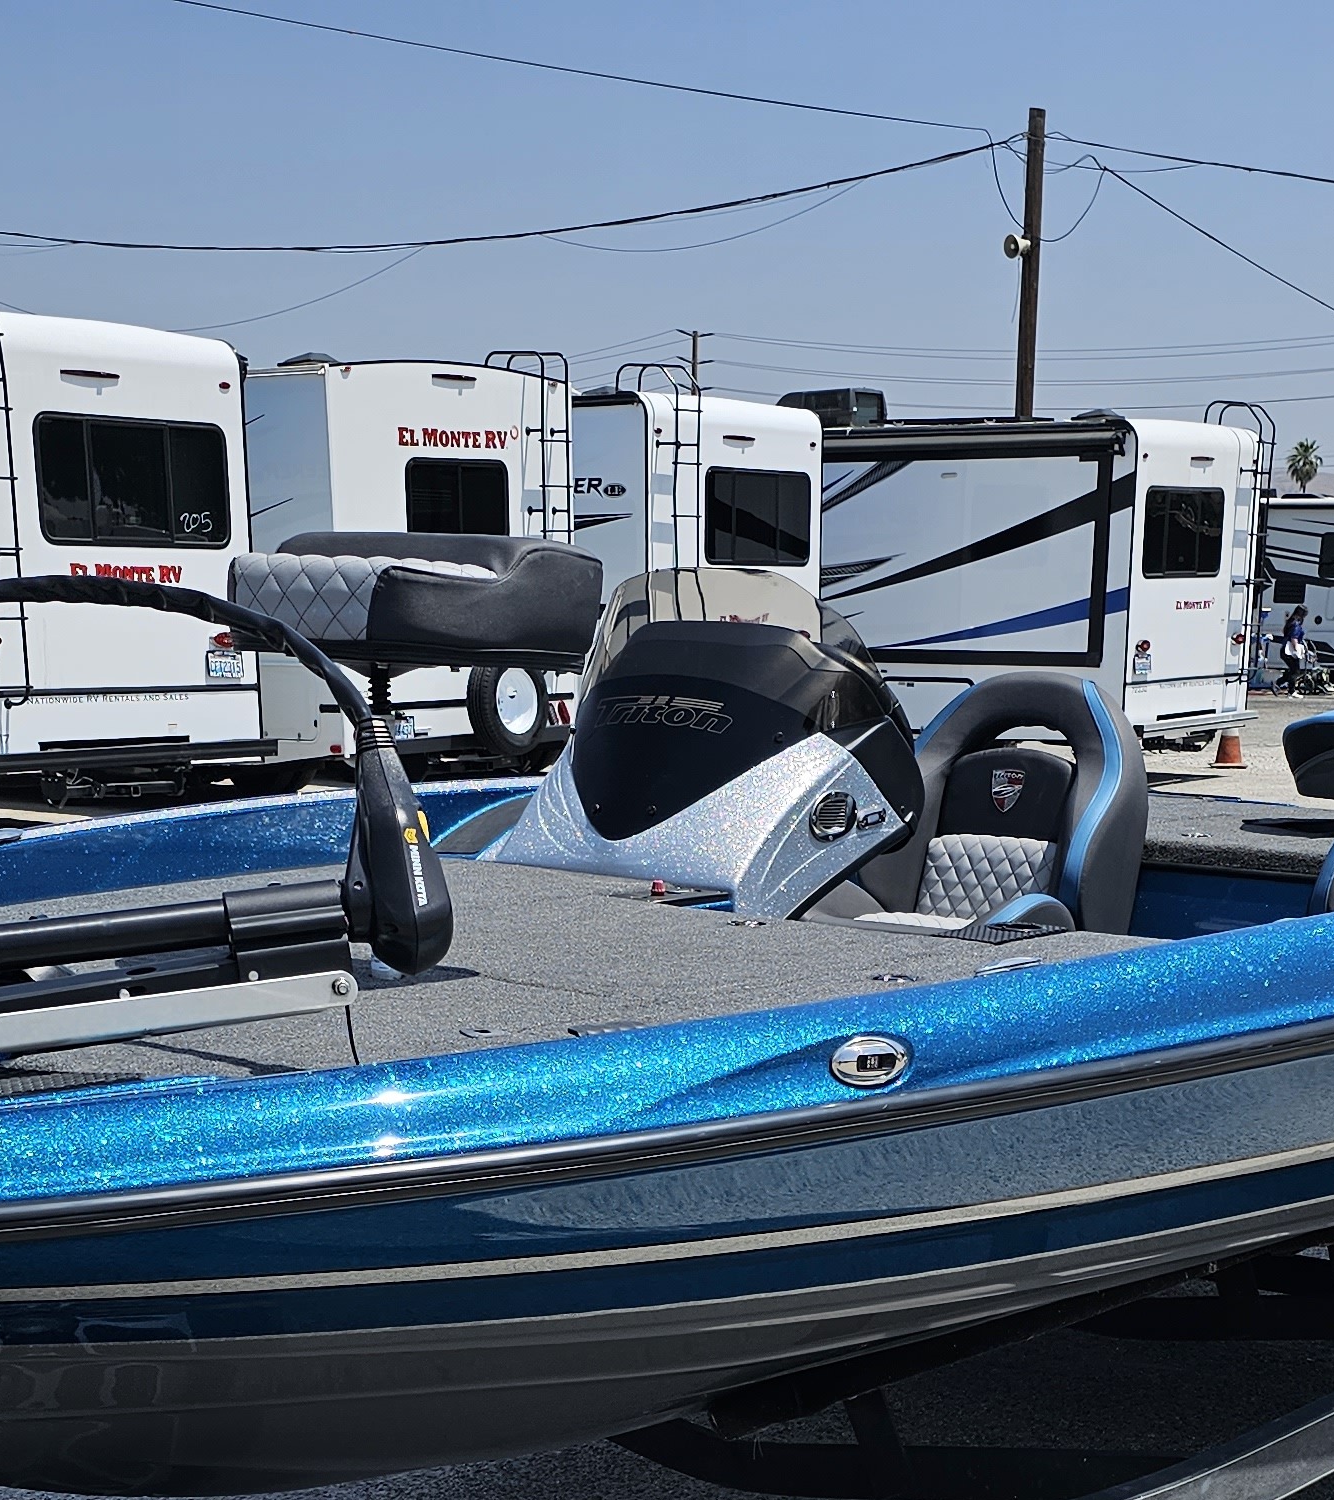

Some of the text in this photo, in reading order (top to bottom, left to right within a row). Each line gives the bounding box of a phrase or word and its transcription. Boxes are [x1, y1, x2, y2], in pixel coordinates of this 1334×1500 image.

[397, 427, 507, 449] EL MONTE RV
[179, 511, 213, 533] 205
[69, 562, 183, 584] EL MONTE RV
[27, 692, 189, 705] NATIONWIDE RV RENTALS AND SALES
[594, 696, 733, 734] Triton
